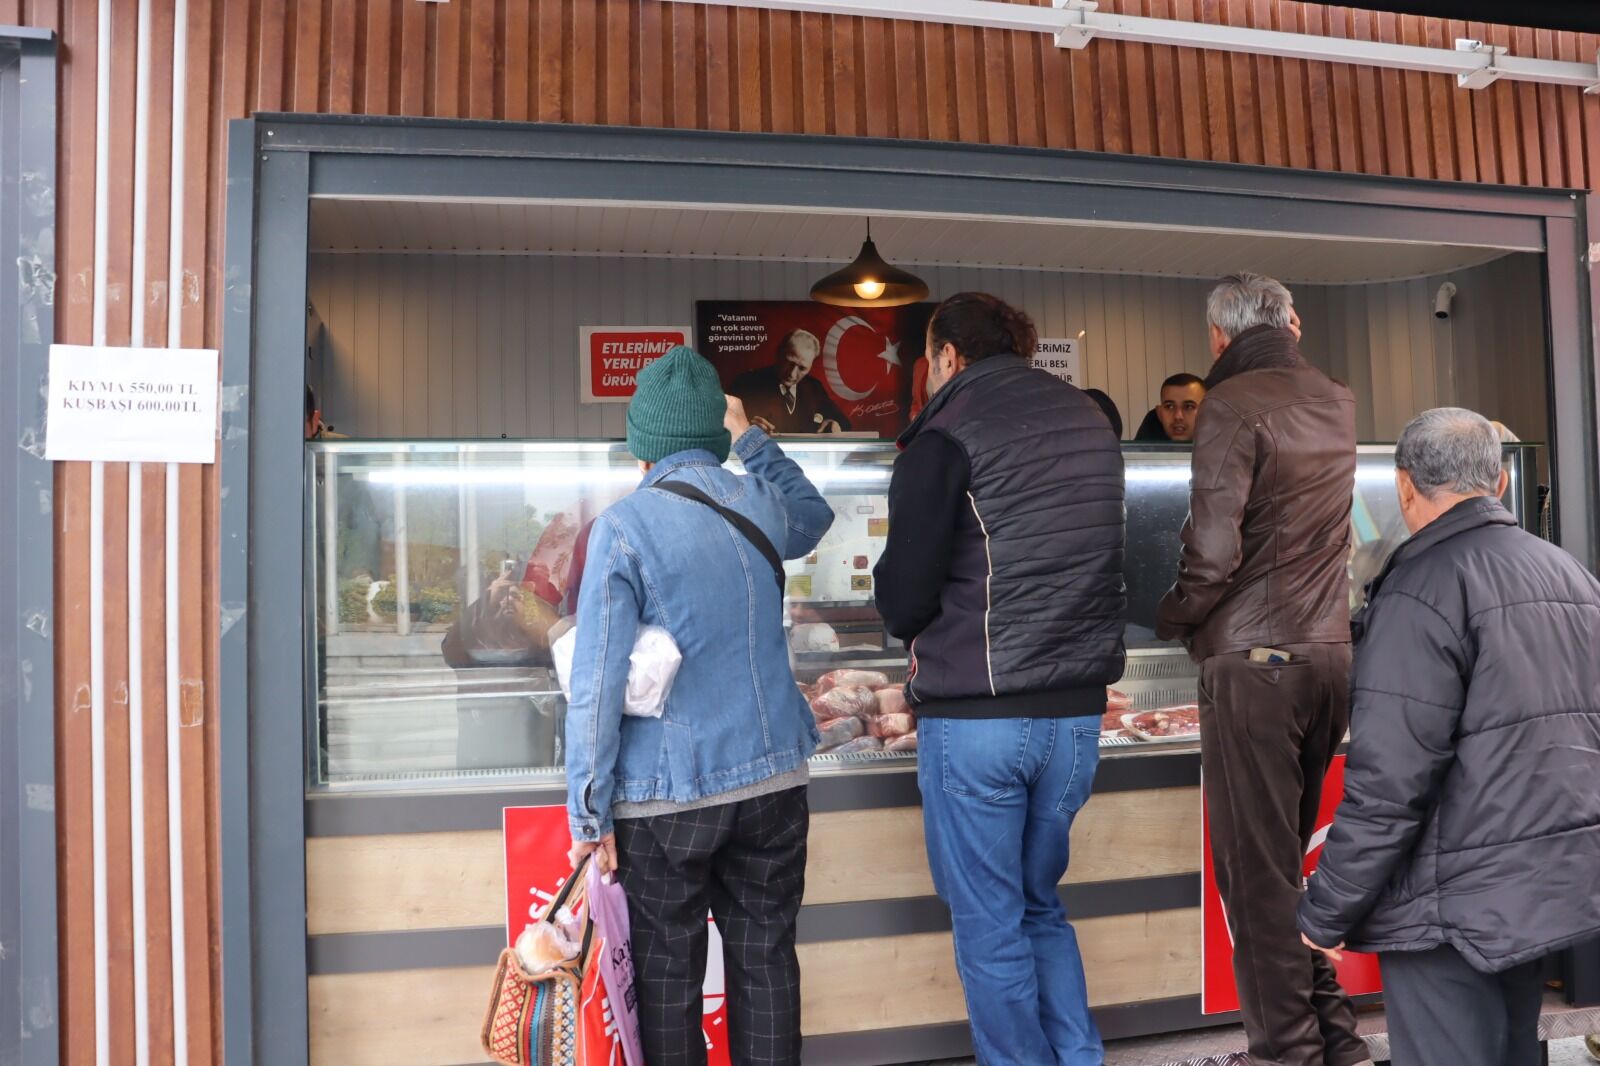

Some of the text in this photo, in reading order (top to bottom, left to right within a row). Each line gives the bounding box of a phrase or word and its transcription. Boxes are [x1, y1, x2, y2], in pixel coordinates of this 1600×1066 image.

[723, 324, 739, 333] çok
[708, 334, 744, 343] görevini
[757, 333, 768, 343] iyi
[603, 354, 641, 369] YERLİ
[602, 373, 637, 386] ÜRÜN
[68, 380, 126, 393] KIYMA
[63, 397, 133, 413] KUŞBAŞI
